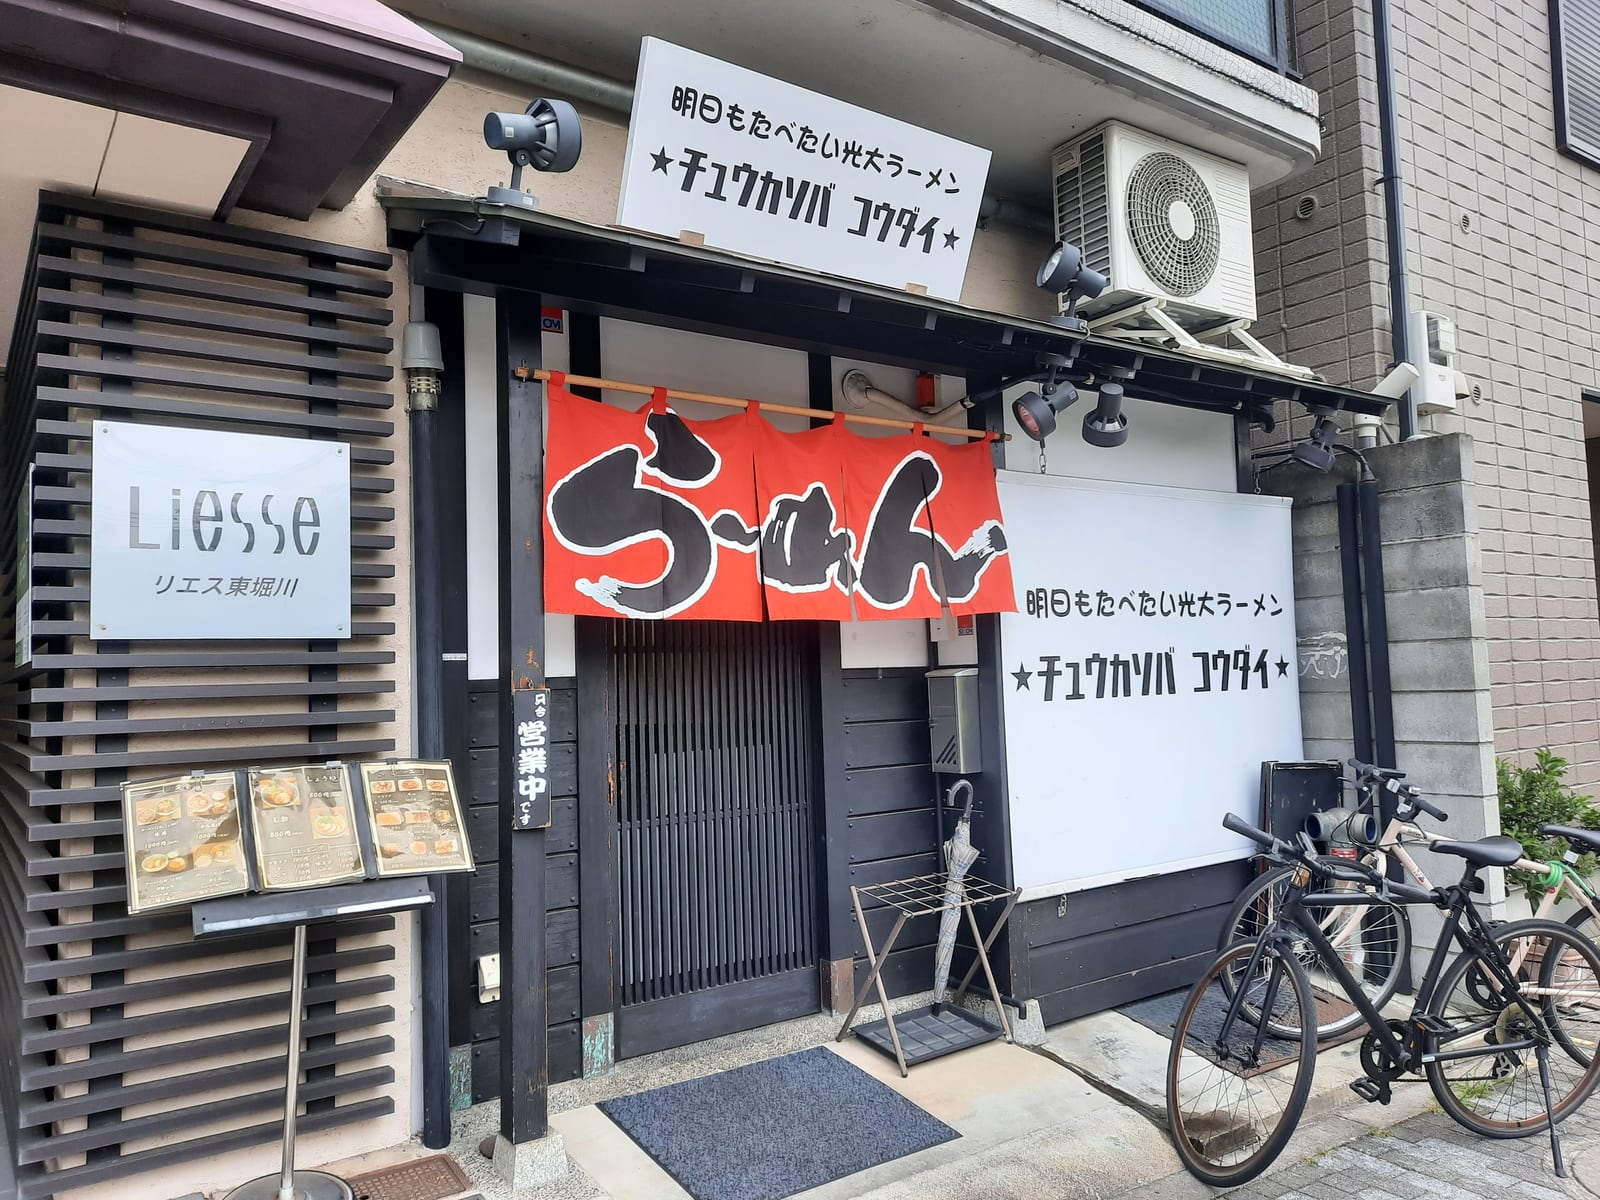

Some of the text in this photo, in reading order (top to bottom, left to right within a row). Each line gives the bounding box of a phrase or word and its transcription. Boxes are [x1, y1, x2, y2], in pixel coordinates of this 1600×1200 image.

[672, 85, 960, 194] 明日もたべたい光大ラーメン
[679, 147, 940, 254] チュウカソバ コウダイ
[129, 486, 321, 556] Liesse
[155, 575, 299, 598] リエス東堀川
[1026, 587, 1283, 619] 明日もたべたい光大ラーメン
[1037, 646, 1177, 702] チュウカソバ
[1192, 644, 1269, 693] コウダイ
